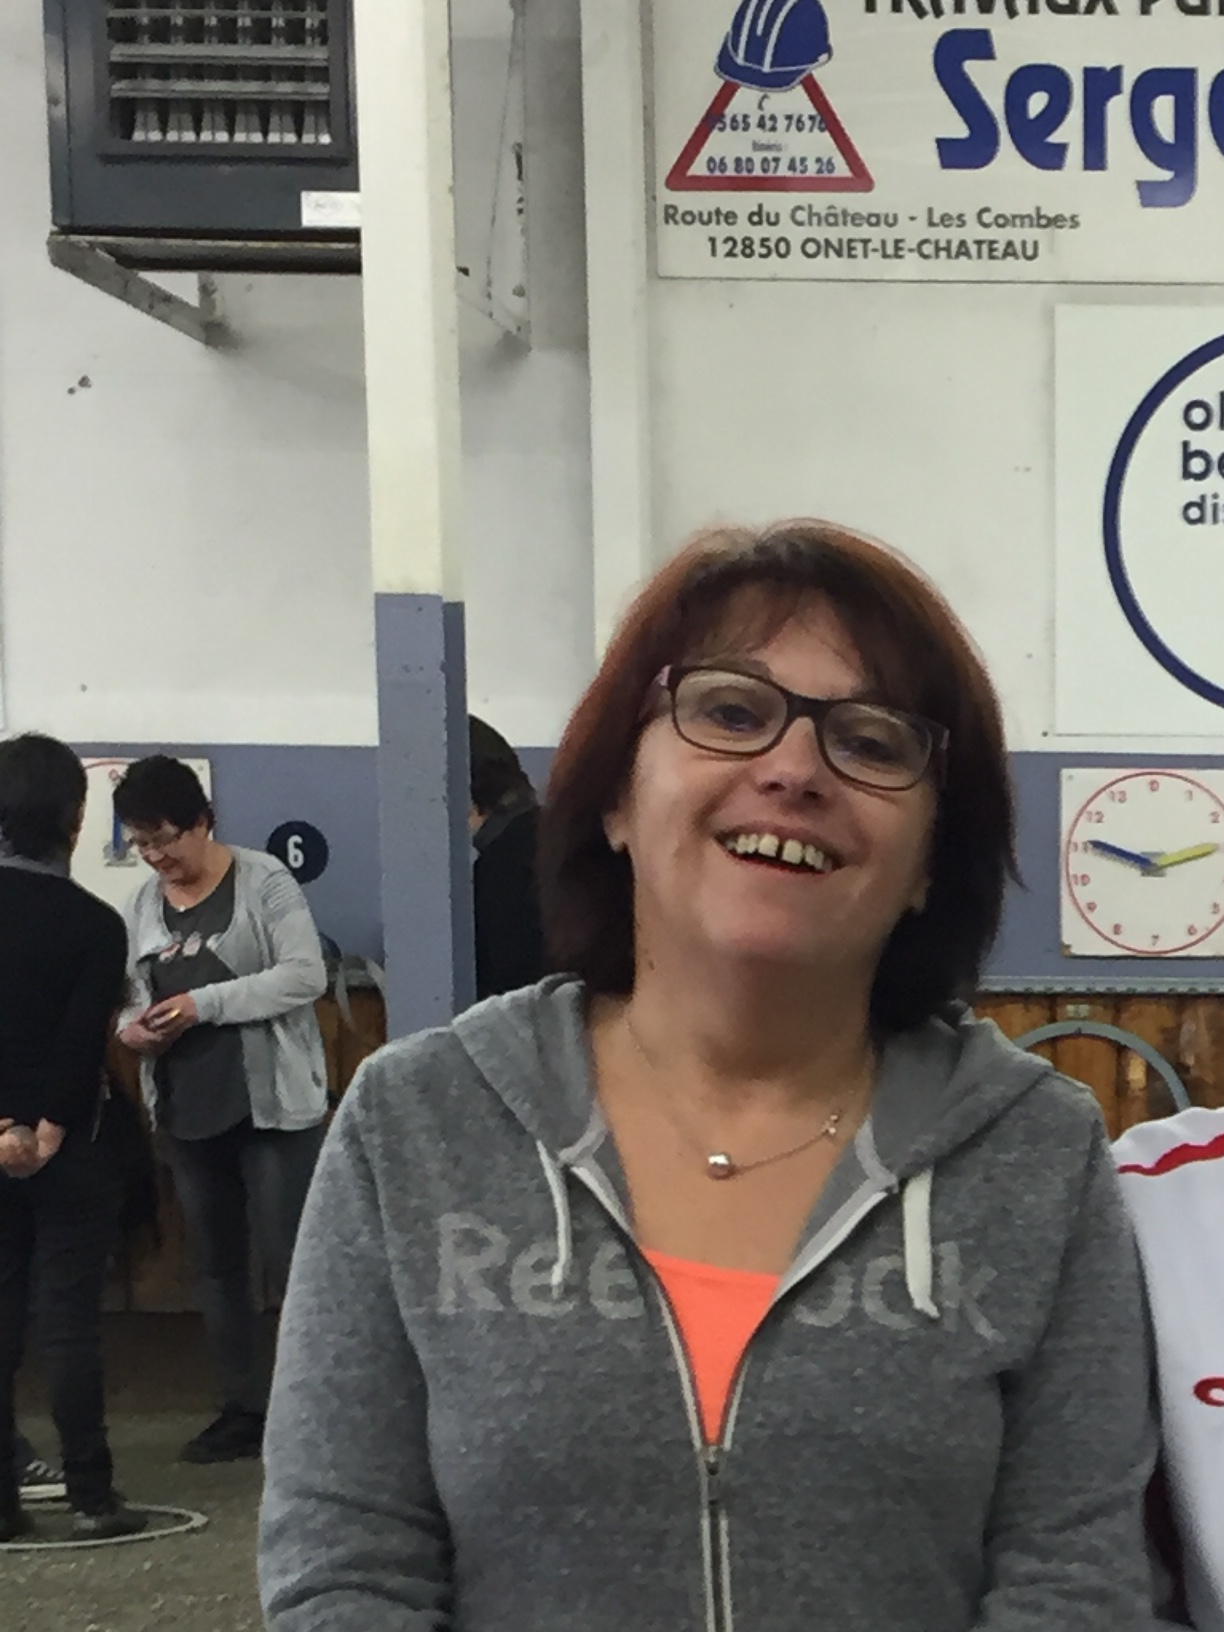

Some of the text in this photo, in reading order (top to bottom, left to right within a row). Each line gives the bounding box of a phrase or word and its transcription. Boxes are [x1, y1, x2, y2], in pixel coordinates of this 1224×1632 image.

[706, 156, 836, 175] 06 80 07 45 26
[664, 203, 738, 227] Route
[747, 203, 781, 227] du
[790, 203, 898, 228] Château
[927, 206, 966, 228] Les
[976, 206, 1081, 229] Combes
[707, 236, 1040, 261] 12850 ONET-LE-CHATEAU
[287, 834, 304, 868] 6
